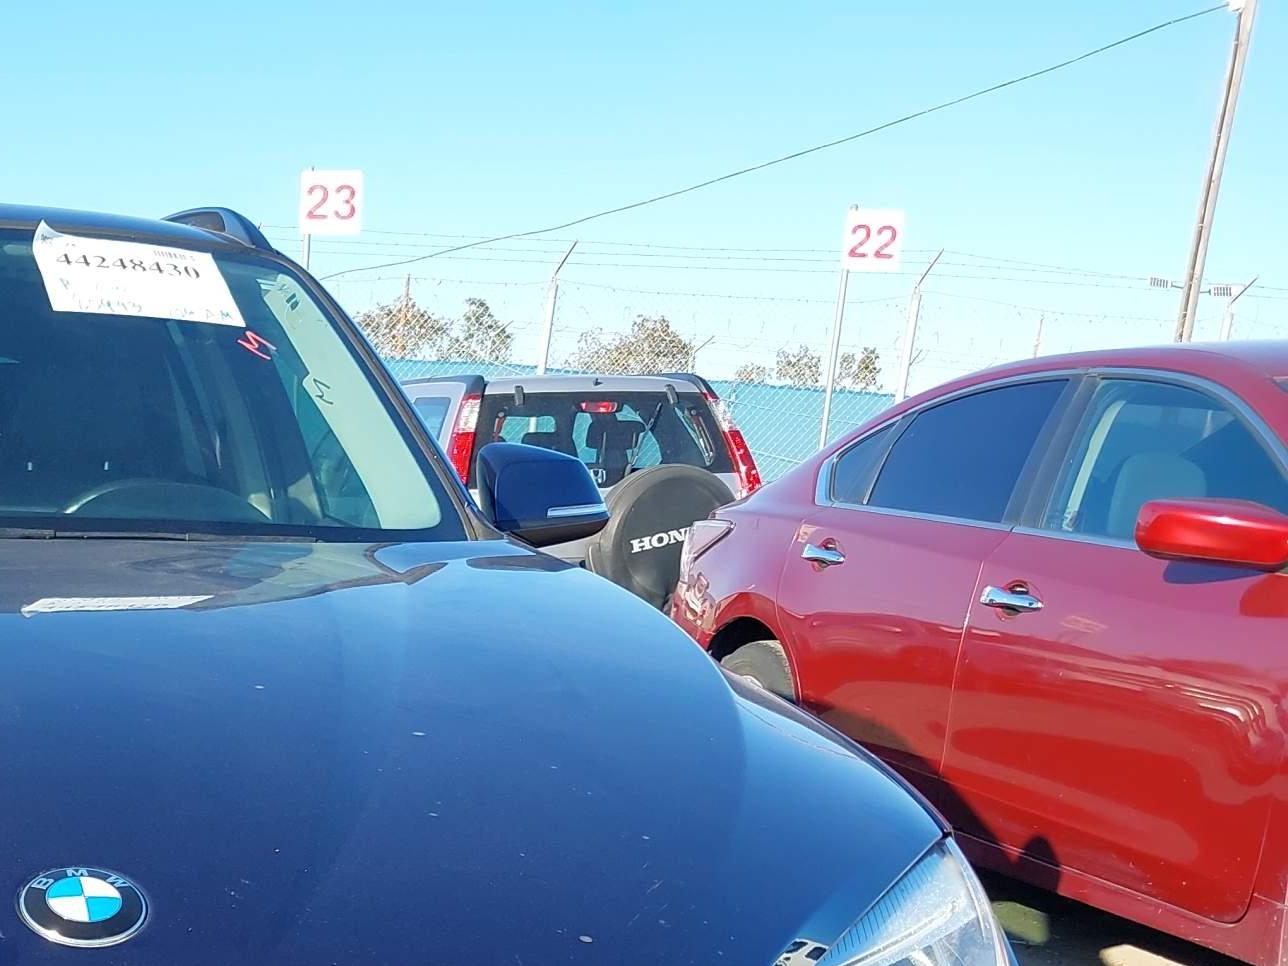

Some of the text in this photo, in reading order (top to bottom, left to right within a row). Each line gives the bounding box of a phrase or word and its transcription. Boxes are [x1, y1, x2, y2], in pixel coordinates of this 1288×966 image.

[307, 184, 356, 220] 23
[848, 224, 897, 259] 22
[56, 252, 201, 280] 44248430
[31, 868, 130, 890] BMW
